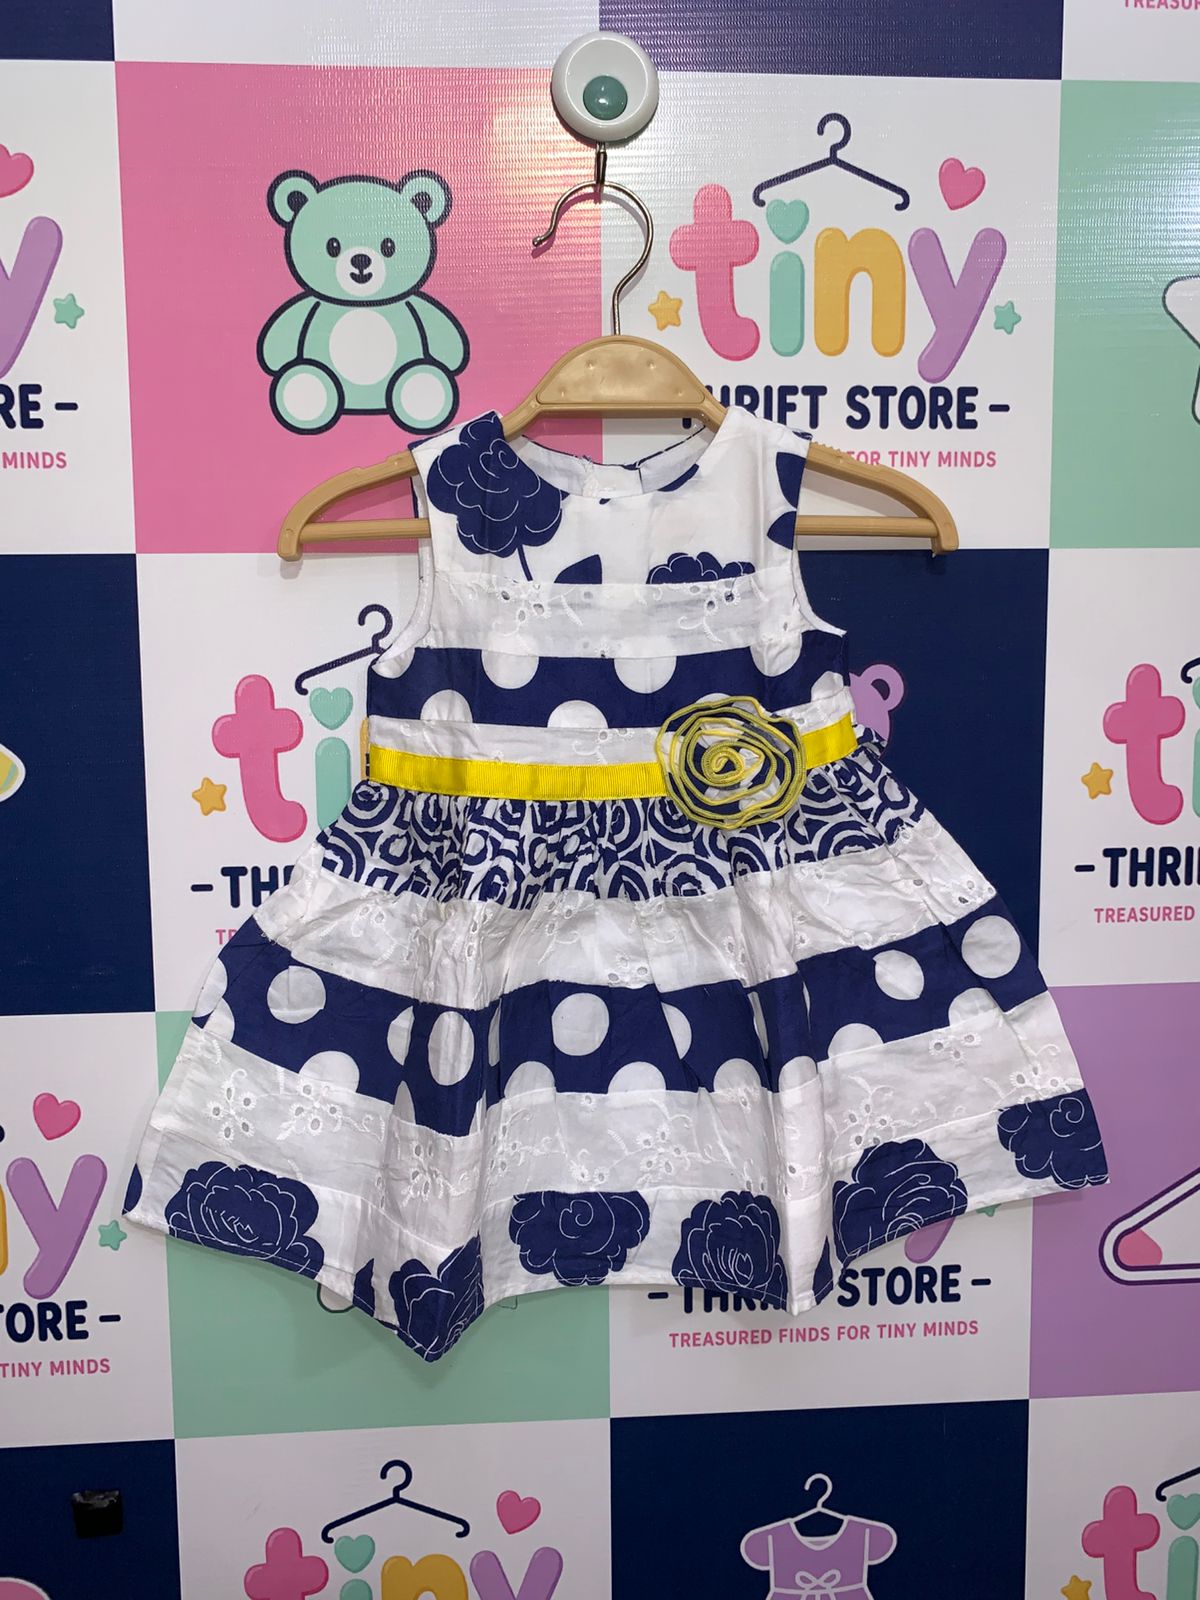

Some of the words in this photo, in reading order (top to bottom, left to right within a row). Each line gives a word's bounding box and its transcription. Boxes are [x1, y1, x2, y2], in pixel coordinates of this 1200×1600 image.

[669, 183, 1007, 384] tiny
[682, 385, 828, 429] RIFT
[846, 385, 979, 430] STORE
[2, 451, 67, 469] MINDS
[888, 451, 931, 468] TINY
[937, 451, 997, 468] MINDS
[1102, 846, 1200, 888] THRI
[1093, 905, 1196, 924] TREASURED
[837, 1264, 962, 1307] STORE
[0, 1300, 90, 1343] ORE
[669, 1327, 773, 1348] TREASURED
[779, 1324, 831, 1343] FINDS
[837, 1325, 870, 1341] FOR
[876, 1323, 917, 1339] TINY
[923, 1320, 979, 1337] MINDS
[0, 1361, 42, 1378] TINY
[49, 1358, 110, 1376] MINDS
